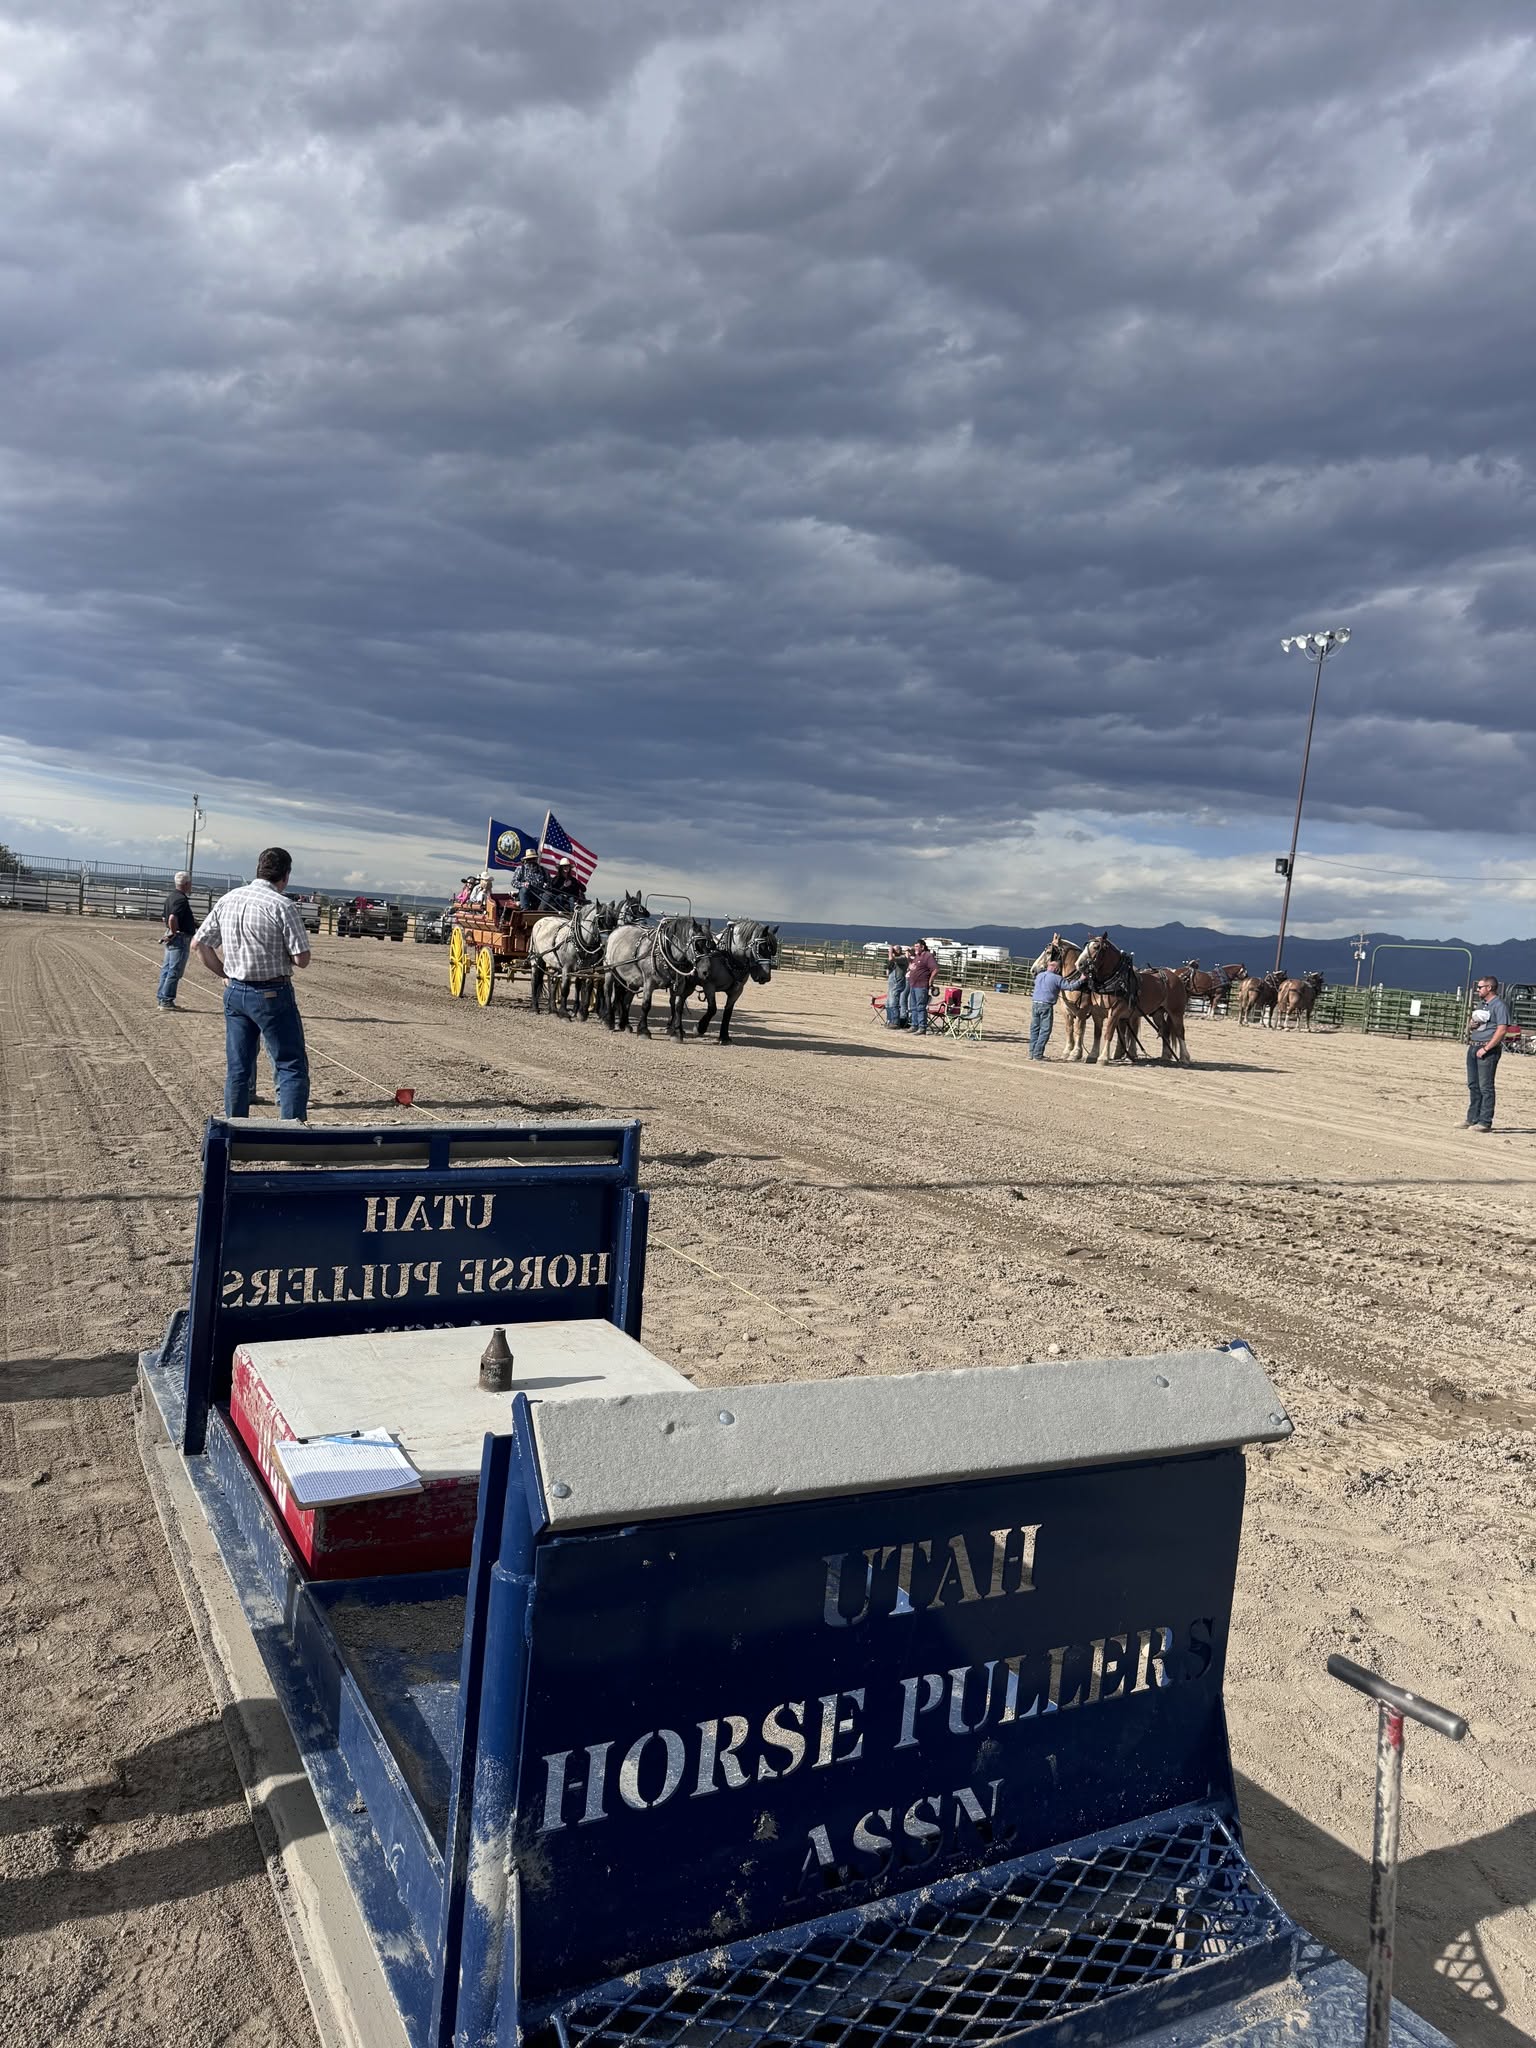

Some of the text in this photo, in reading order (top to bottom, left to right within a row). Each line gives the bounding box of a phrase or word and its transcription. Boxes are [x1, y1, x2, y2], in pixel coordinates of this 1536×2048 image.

[822, 1524, 1042, 1626] UTAH
[538, 1617, 1213, 1832] HORSE PULLERS
